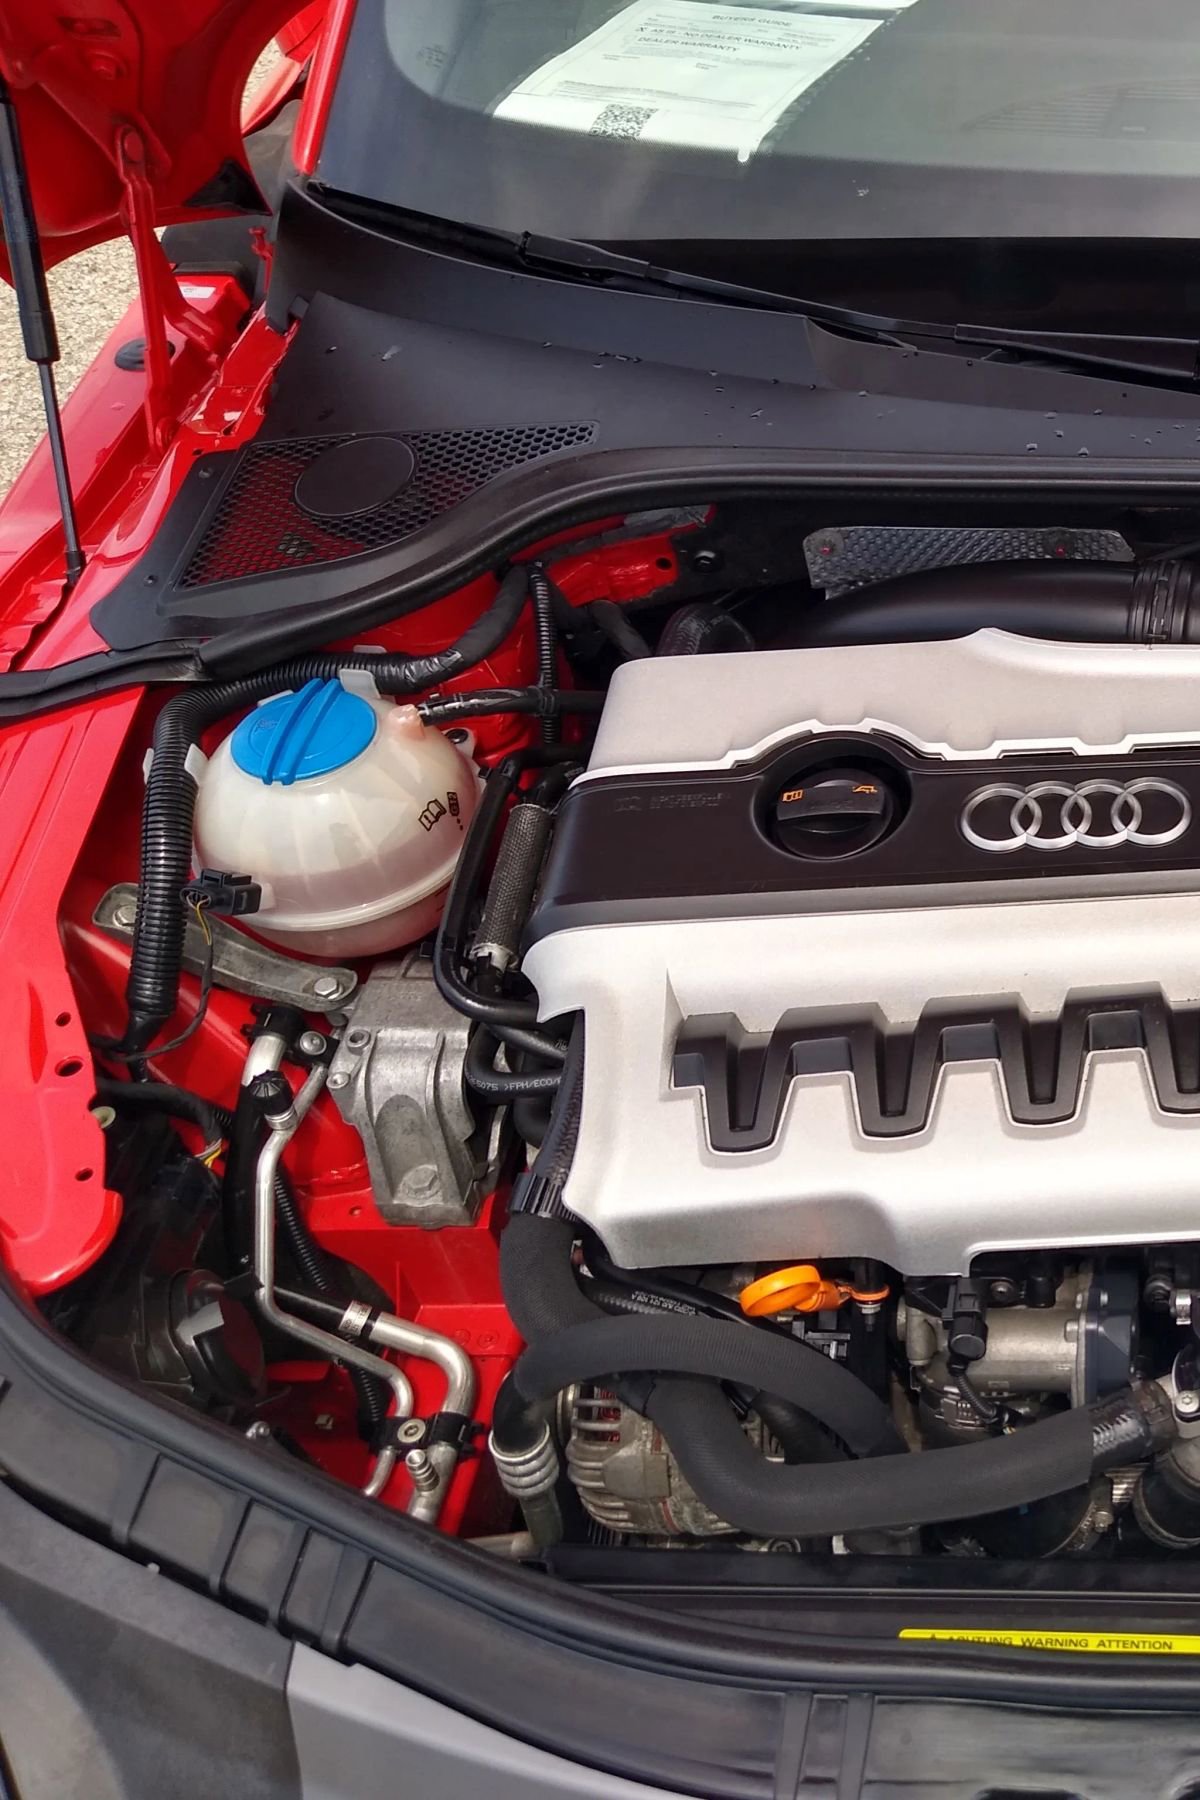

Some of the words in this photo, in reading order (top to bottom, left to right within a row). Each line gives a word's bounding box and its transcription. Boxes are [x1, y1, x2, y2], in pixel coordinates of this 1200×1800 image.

[712, 14, 756, 22] BUYERS
[758, 18, 793, 27] GUIDE
[637, 36, 679, 45] DEALER
[680, 40, 740, 52] WARRANTY
[700, 33, 742, 42] DEALER
[744, 37, 801, 50] WARRANTY
[1021, 1636, 1089, 1649] WARNING
[1096, 1638, 1173, 1651] ATTENTION
